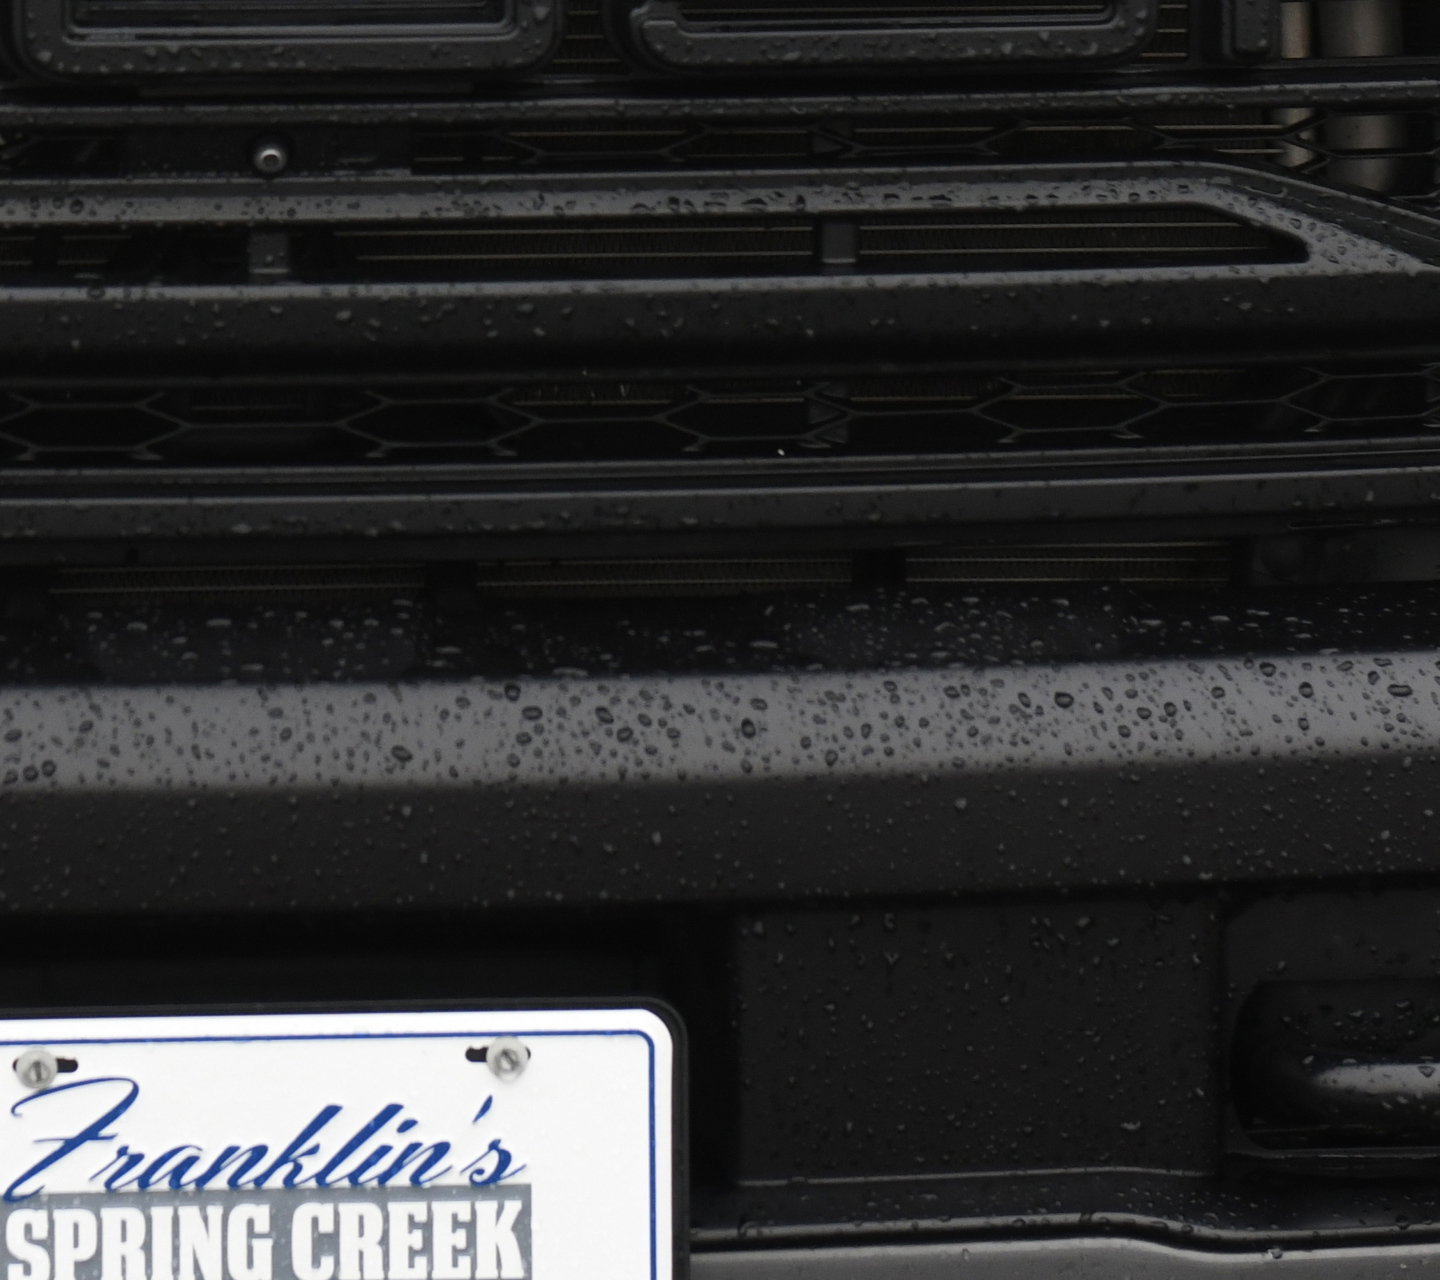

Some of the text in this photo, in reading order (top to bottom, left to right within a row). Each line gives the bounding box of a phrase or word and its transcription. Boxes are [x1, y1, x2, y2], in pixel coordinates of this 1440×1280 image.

[3, 1077, 527, 1203] Franklin's
[6, 1200, 525, 1280] SPRING CREEK
